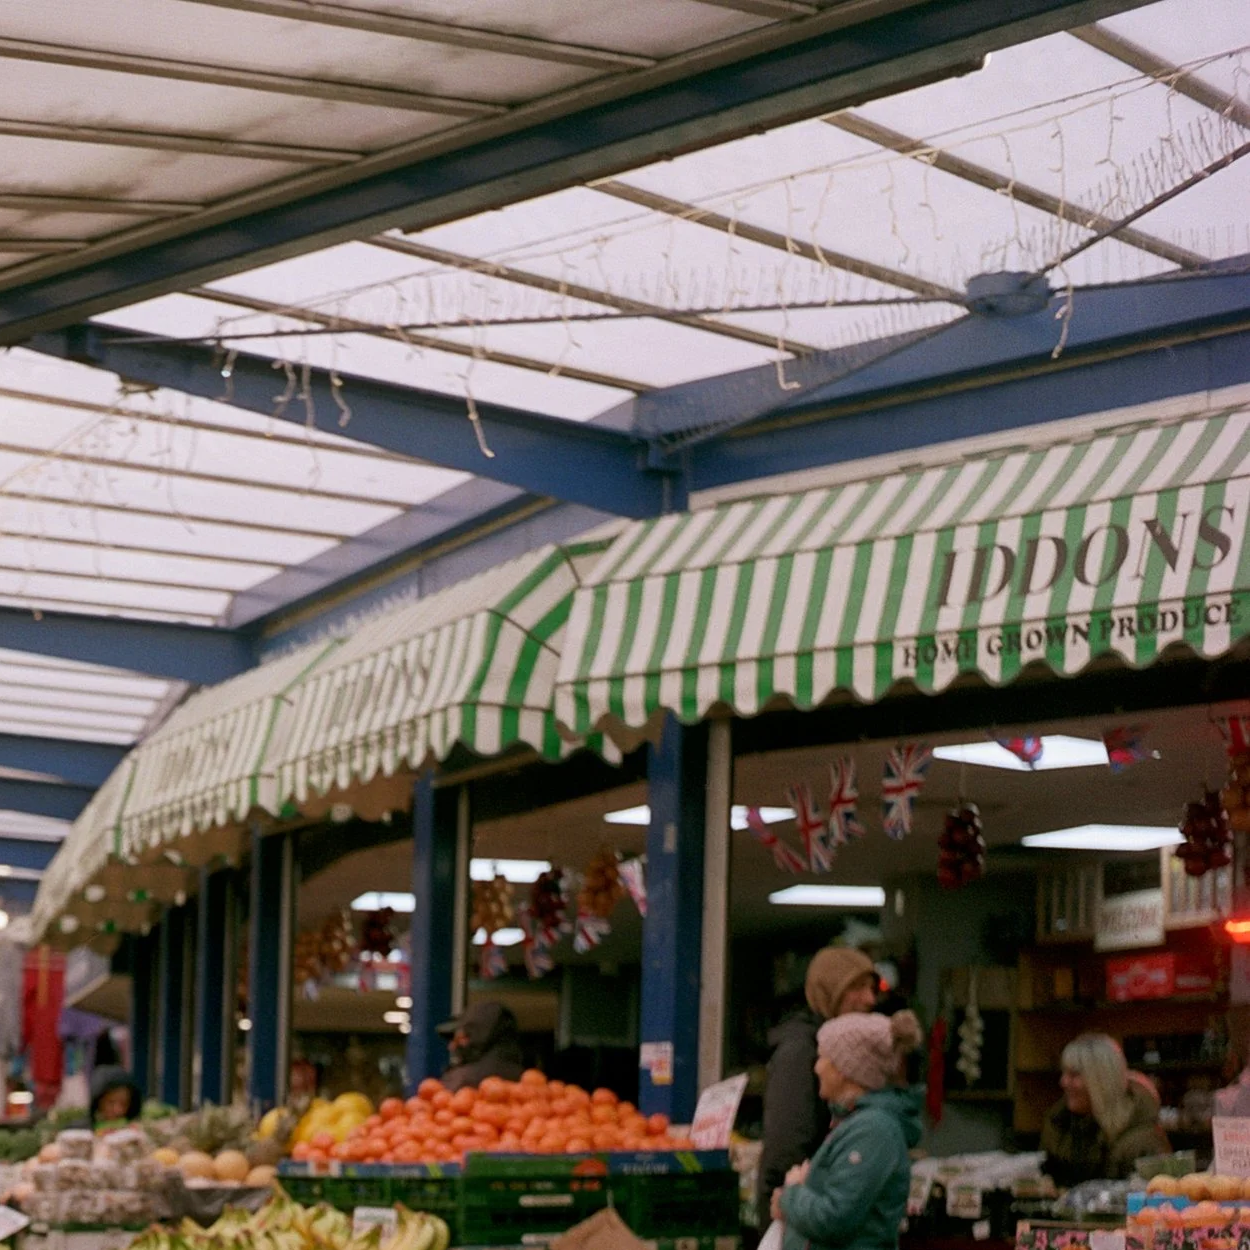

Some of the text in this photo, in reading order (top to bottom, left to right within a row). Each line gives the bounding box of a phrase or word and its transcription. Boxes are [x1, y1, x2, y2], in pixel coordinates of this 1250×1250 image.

[937, 504, 1236, 608] IDDONS
[902, 599, 1241, 670] HOME GROWN PRODUCE
